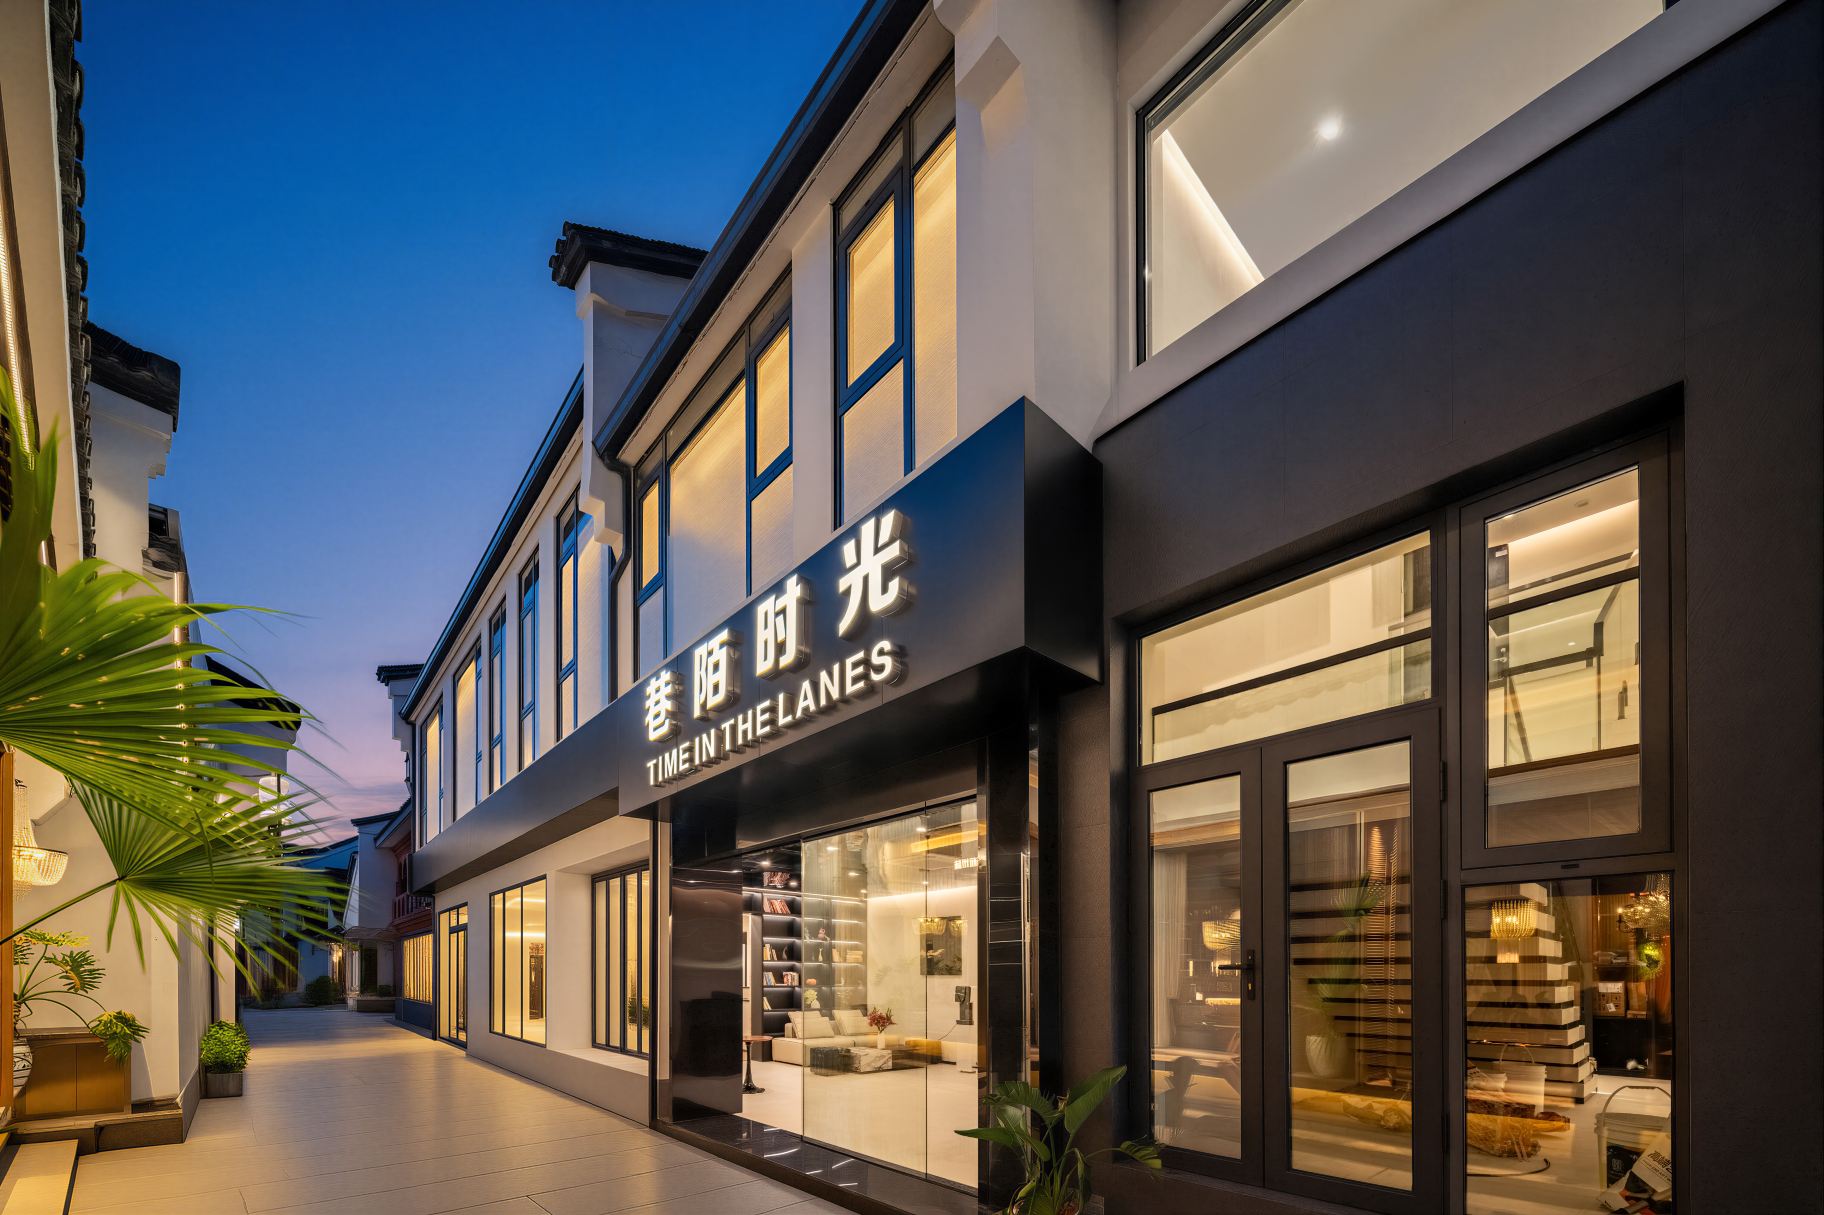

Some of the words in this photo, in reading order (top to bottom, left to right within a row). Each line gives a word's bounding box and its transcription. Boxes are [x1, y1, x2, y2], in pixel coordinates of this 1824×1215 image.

[645, 509, 902, 741] 巷陌时光
[646, 741, 690, 786] TIME
[694, 728, 716, 765] IN
[721, 699, 771, 751] THE
[778, 640, 893, 727] LANES
